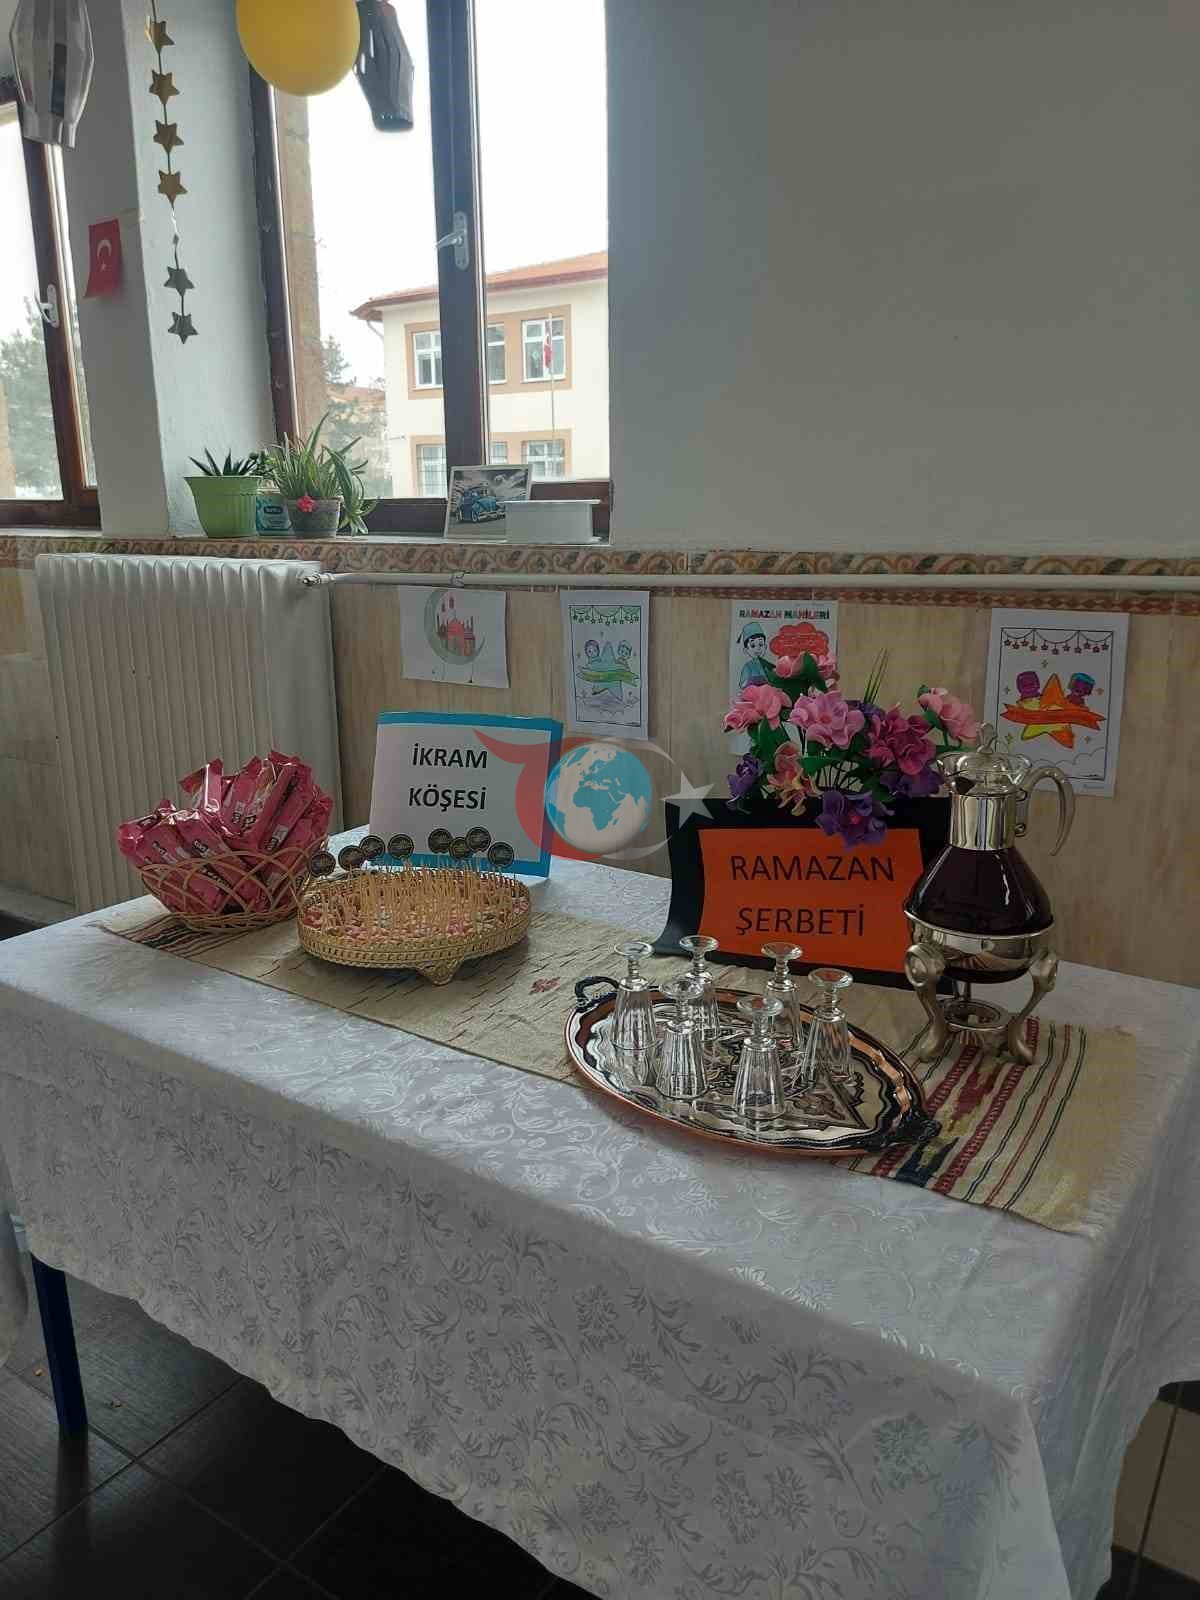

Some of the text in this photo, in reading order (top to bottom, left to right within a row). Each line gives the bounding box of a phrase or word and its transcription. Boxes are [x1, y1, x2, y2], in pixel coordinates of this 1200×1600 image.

[412, 743, 488, 769] İKRAM
[408, 784, 487, 812] KÖŞESİ
[730, 855, 895, 882] RAMAZAN
[735, 903, 865, 937] ŞERBETİ
